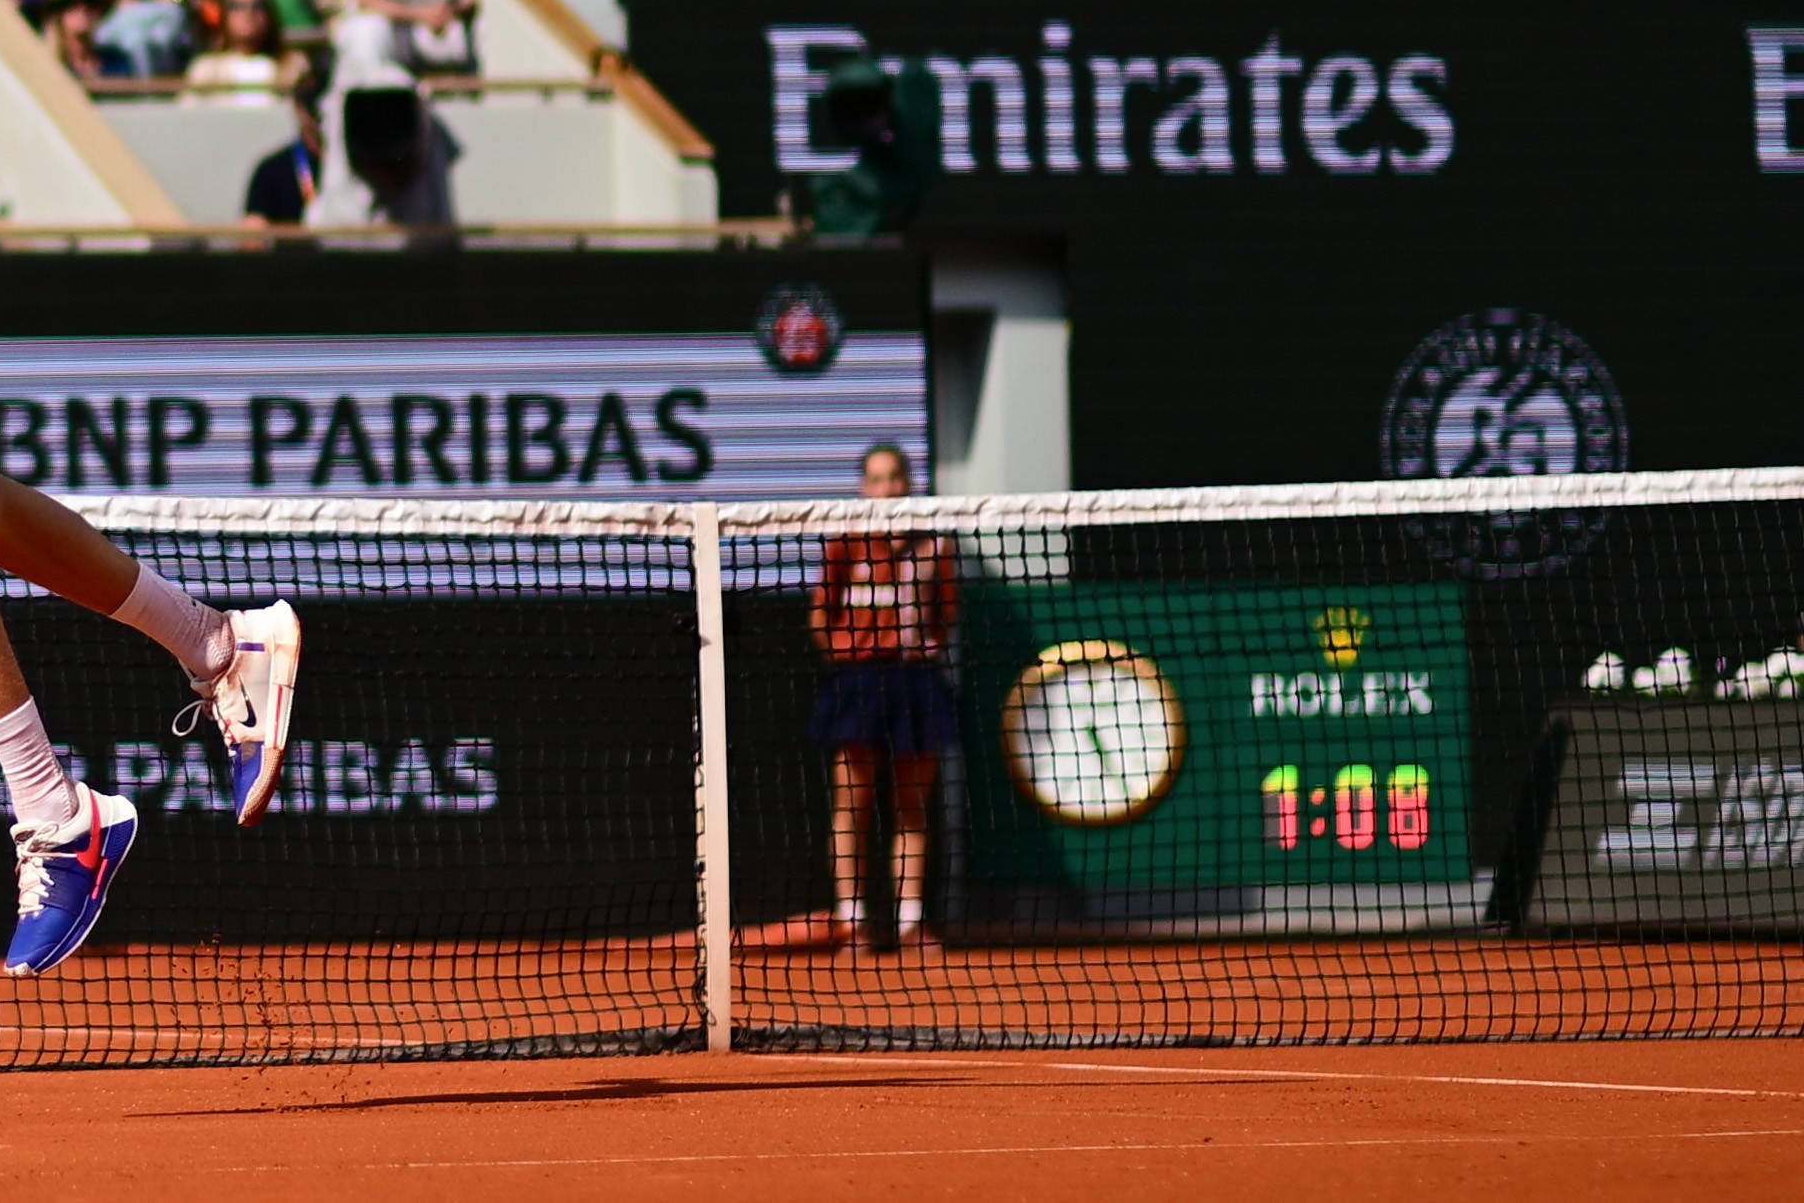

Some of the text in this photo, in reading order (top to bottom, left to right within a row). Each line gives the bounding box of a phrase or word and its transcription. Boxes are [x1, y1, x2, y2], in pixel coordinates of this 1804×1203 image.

[765, 20, 1454, 173] Emirates
[249, 388, 714, 488] PARIBAS
[1251, 671, 1435, 718] ROLEX
[114, 737, 500, 816] PAIBAS
[1261, 764, 1429, 850] 1:08
